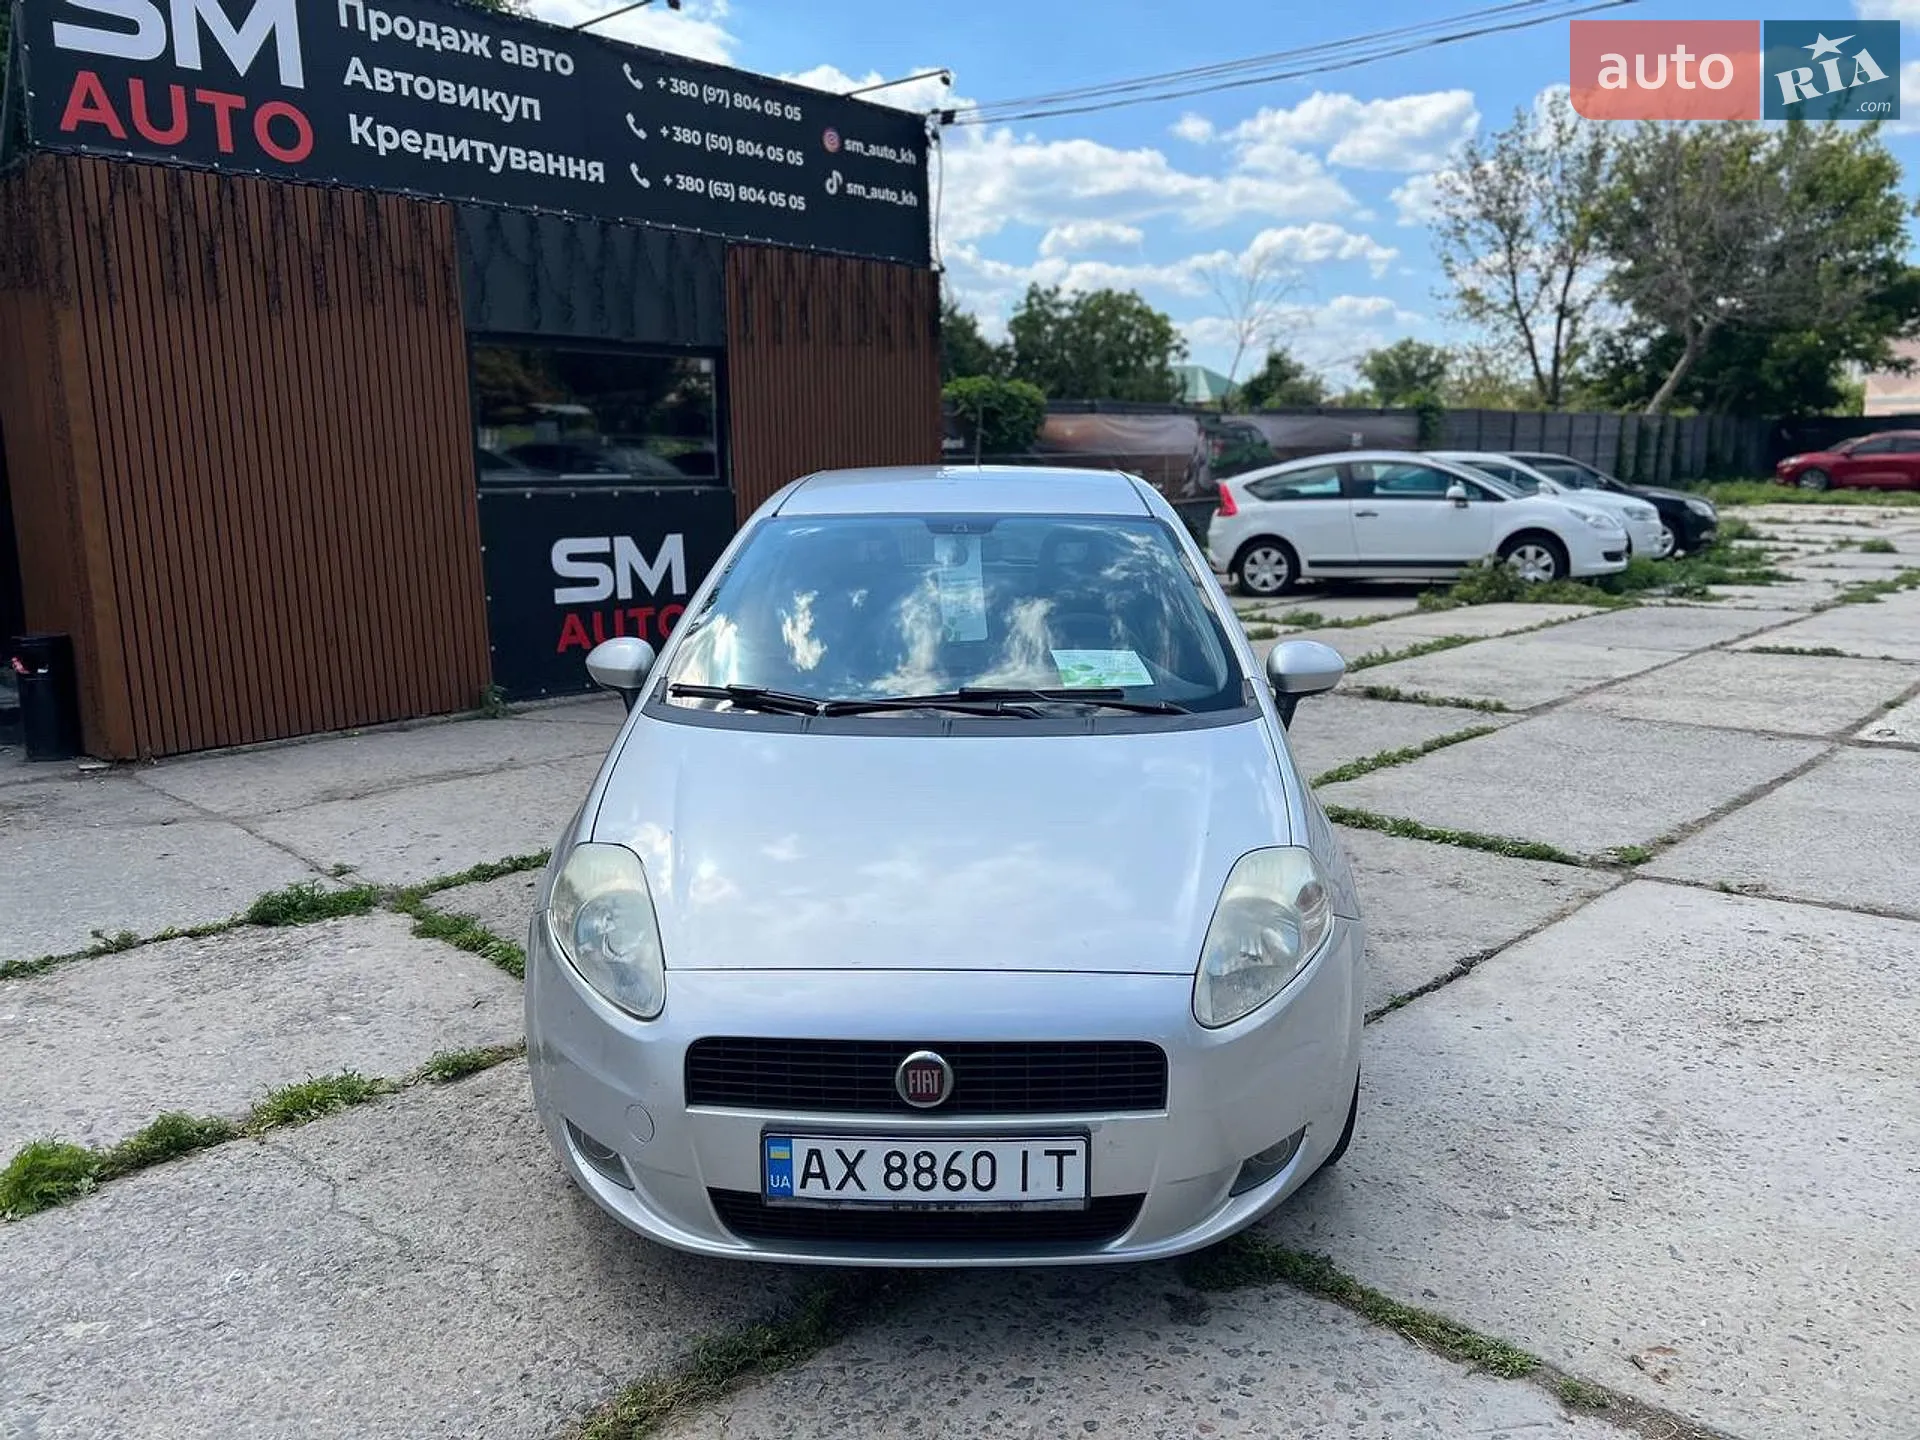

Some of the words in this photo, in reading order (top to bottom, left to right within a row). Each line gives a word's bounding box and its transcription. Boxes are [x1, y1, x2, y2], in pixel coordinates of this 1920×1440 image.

[337, 0, 491, 59] Продаж
[500, 37, 575, 76] авто
[343, 56, 541, 122] Автовикуп
[669, 78, 699, 98] 380
[702, 84, 731, 108] (97)
[734, 93, 762, 112] 804
[764, 101, 782, 117] 05
[784, 106, 802, 121] 05
[60, 70, 314, 163] AUTO
[349, 113, 605, 184] Кредитування
[672, 126, 701, 146] 380
[705, 132, 733, 156] (50)
[736, 140, 764, 159] 804
[767, 147, 784, 163] 05
[786, 150, 804, 166] 05
[844, 137, 917, 166] sm_auto_kh
[676, 174, 705, 193] 380
[708, 180, 736, 202] (63)
[738, 186, 766, 204] 804
[769, 193, 786, 208] 05
[788, 196, 806, 211] 05
[846, 181, 919, 208] sm_auto_kh
[551, 533, 687, 604] SM
[908, 1069, 942, 1094] FIAT
[770, 1174, 791, 1189] UA
[799, 1148, 867, 1192] AX
[883, 1150, 997, 1193] 8860
[1021, 1149, 1078, 1192] IT
